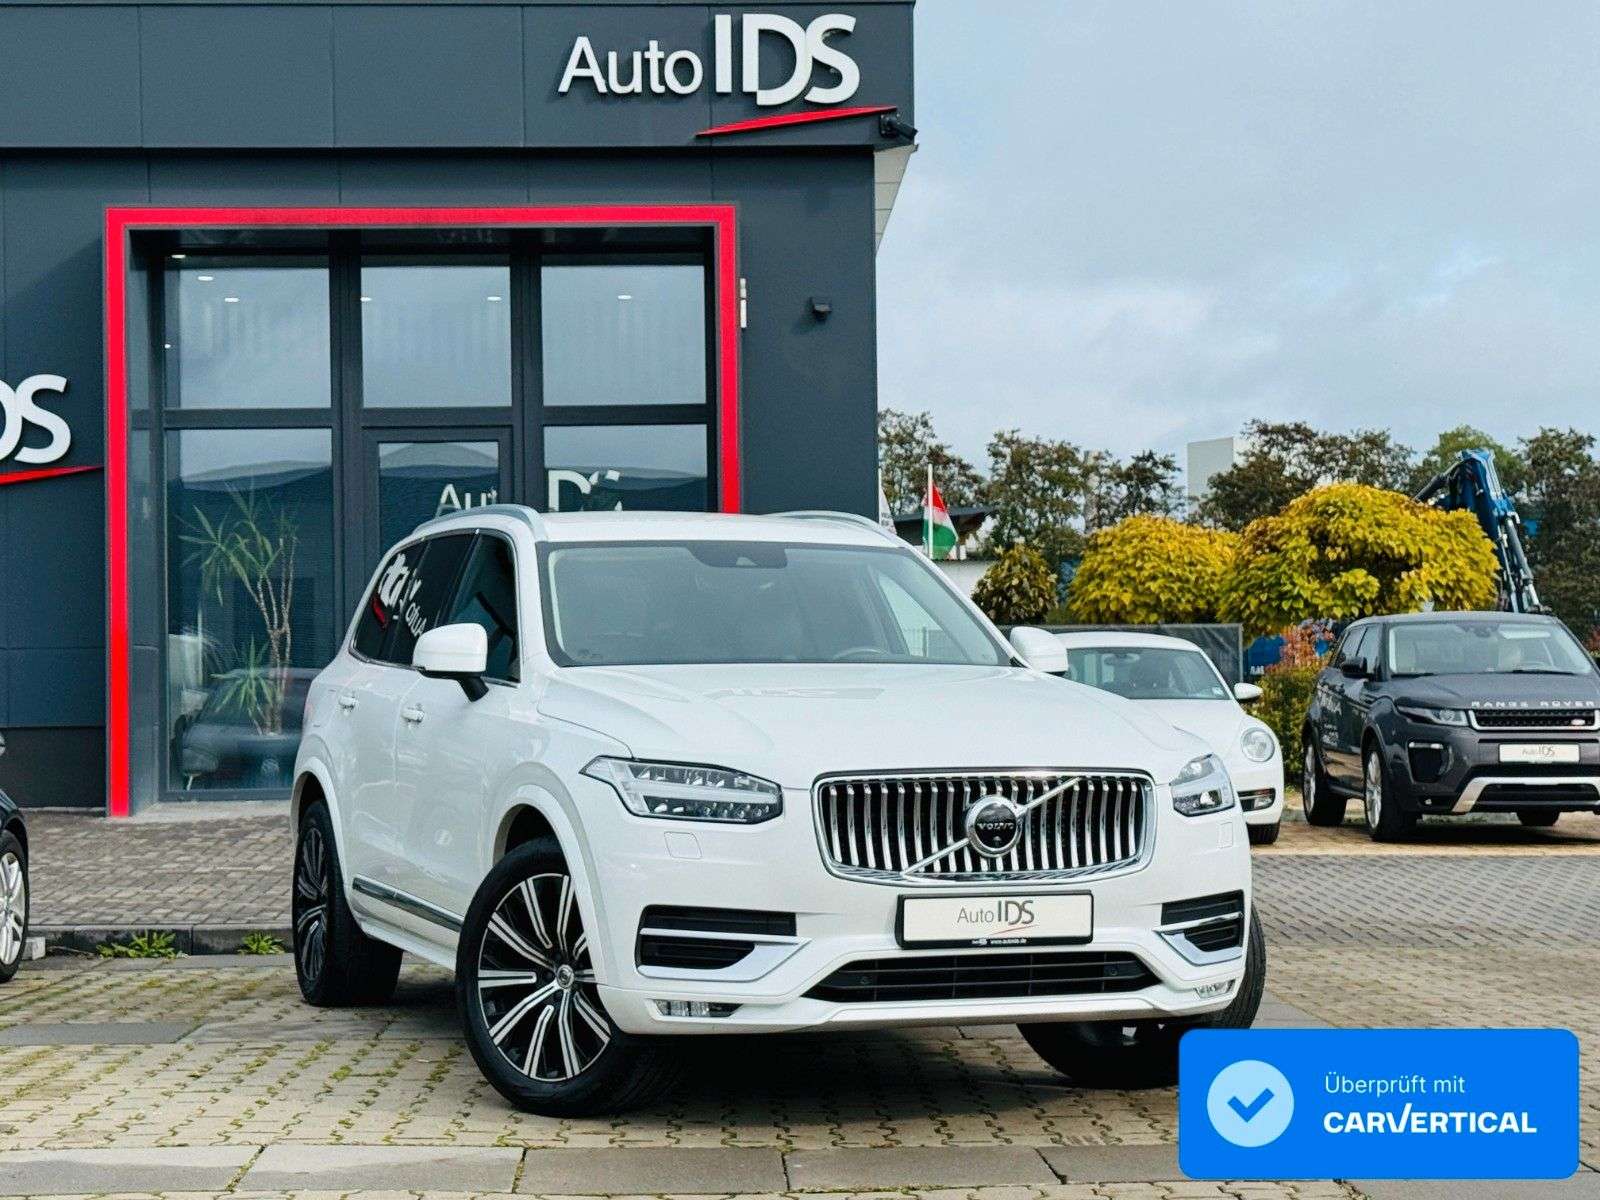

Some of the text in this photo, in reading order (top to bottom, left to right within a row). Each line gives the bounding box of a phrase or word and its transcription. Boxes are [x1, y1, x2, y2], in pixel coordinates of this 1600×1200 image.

[558, 13, 860, 105] Auto IDS
[957, 900, 1035, 926] Auto IDS
